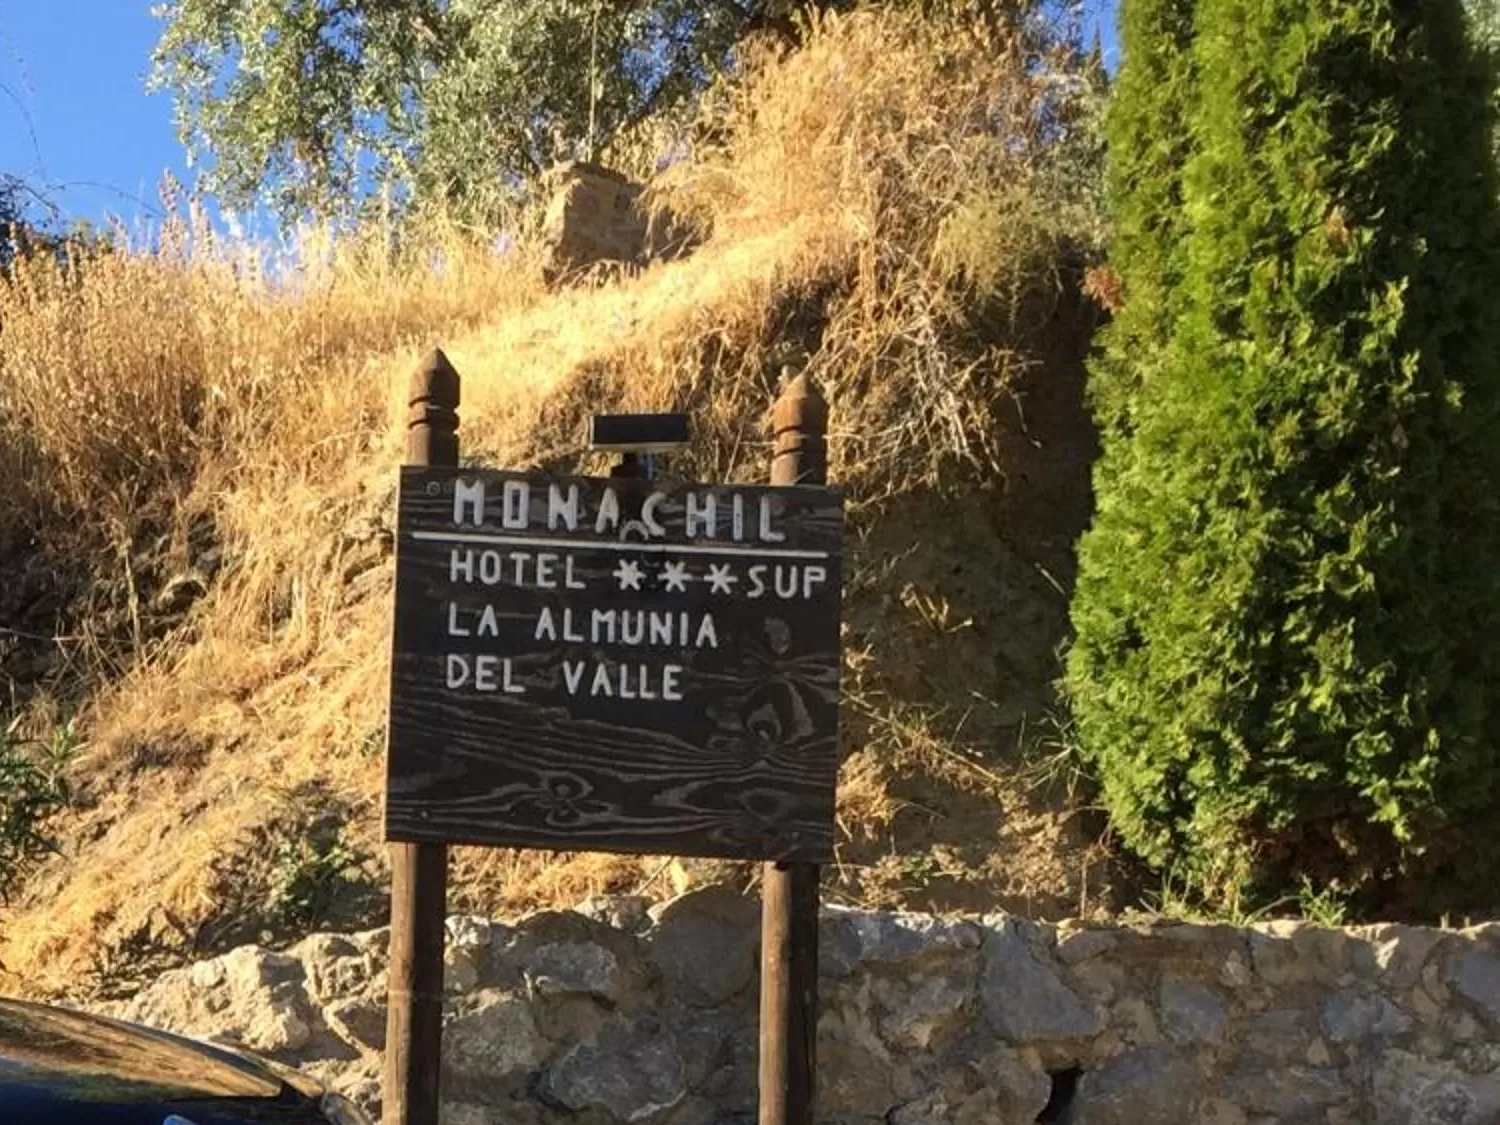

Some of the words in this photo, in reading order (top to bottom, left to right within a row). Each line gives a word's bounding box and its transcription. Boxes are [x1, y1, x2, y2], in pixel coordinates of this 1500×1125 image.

[452, 478, 787, 543] MONACHIL
[450, 549, 588, 590] HOTEL
[447, 602, 499, 638] LA
[534, 607, 719, 649] ALMUNIA
[445, 654, 526, 694] DEL
[562, 660, 684, 701] VALLE
